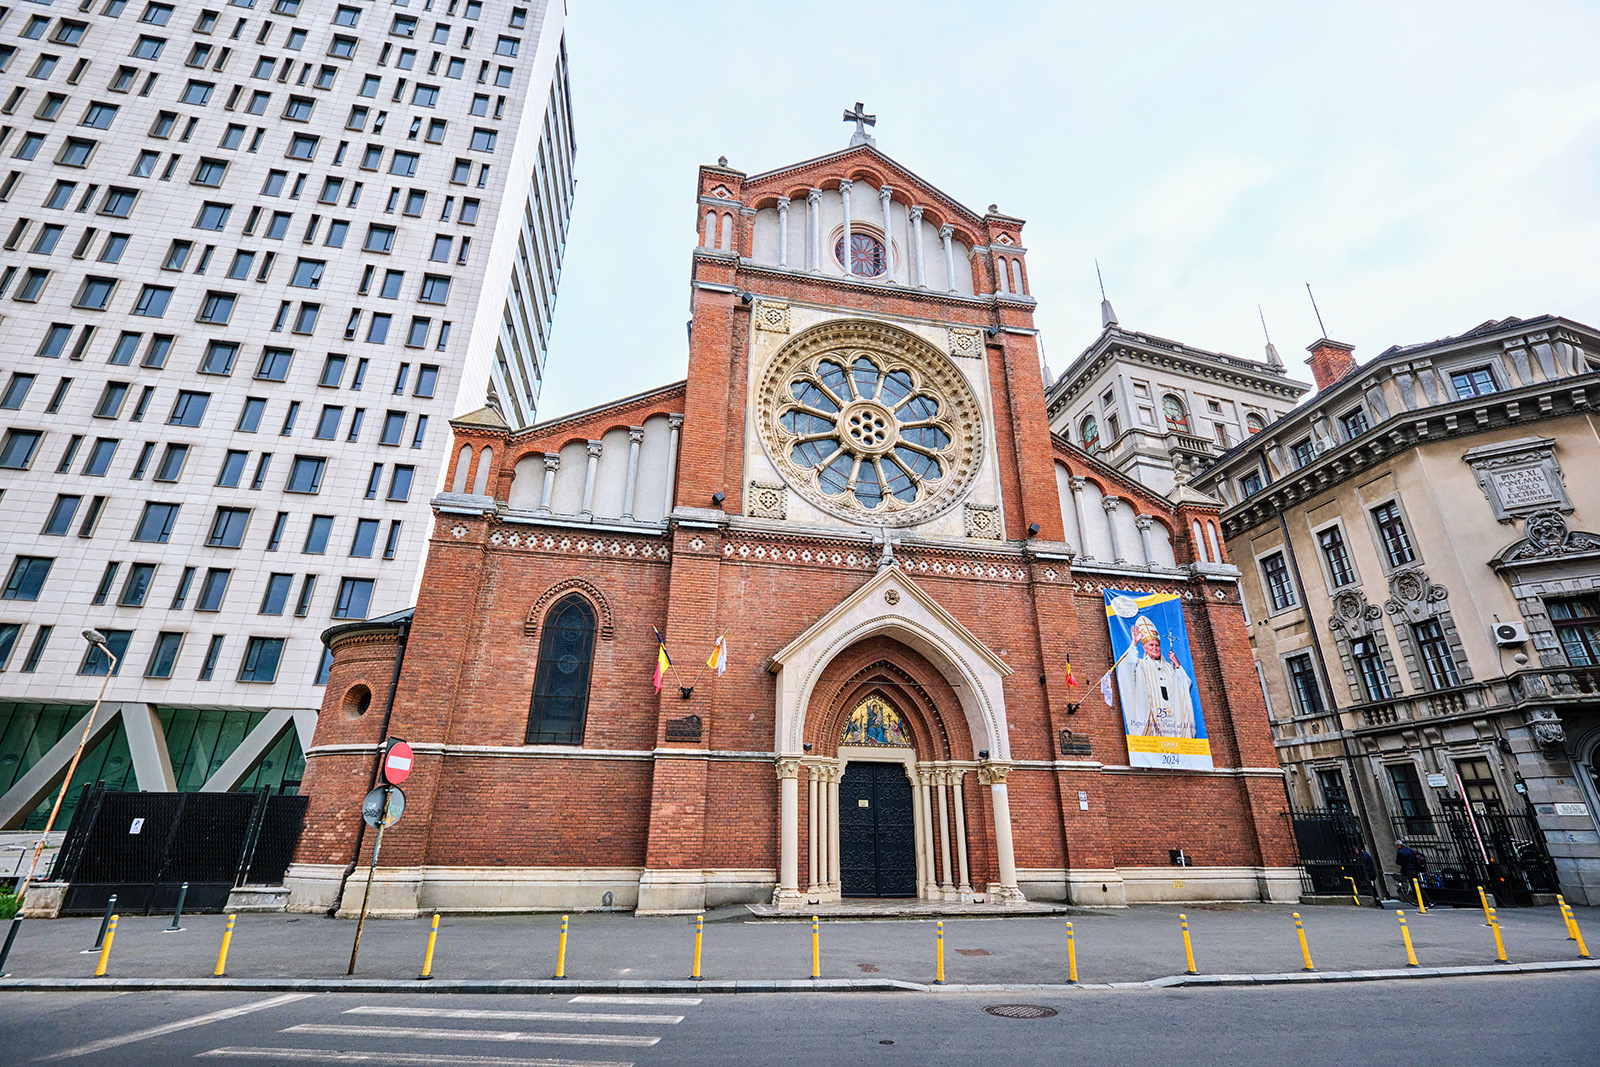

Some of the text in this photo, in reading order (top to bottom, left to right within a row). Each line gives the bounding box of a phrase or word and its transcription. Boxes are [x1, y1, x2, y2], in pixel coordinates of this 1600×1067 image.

[1517, 483, 1539, 491] SOLO
[1156, 707, 1168, 719] 25
[1160, 741, 1178, 750] 1999
[1162, 755, 1179, 764] 2024
